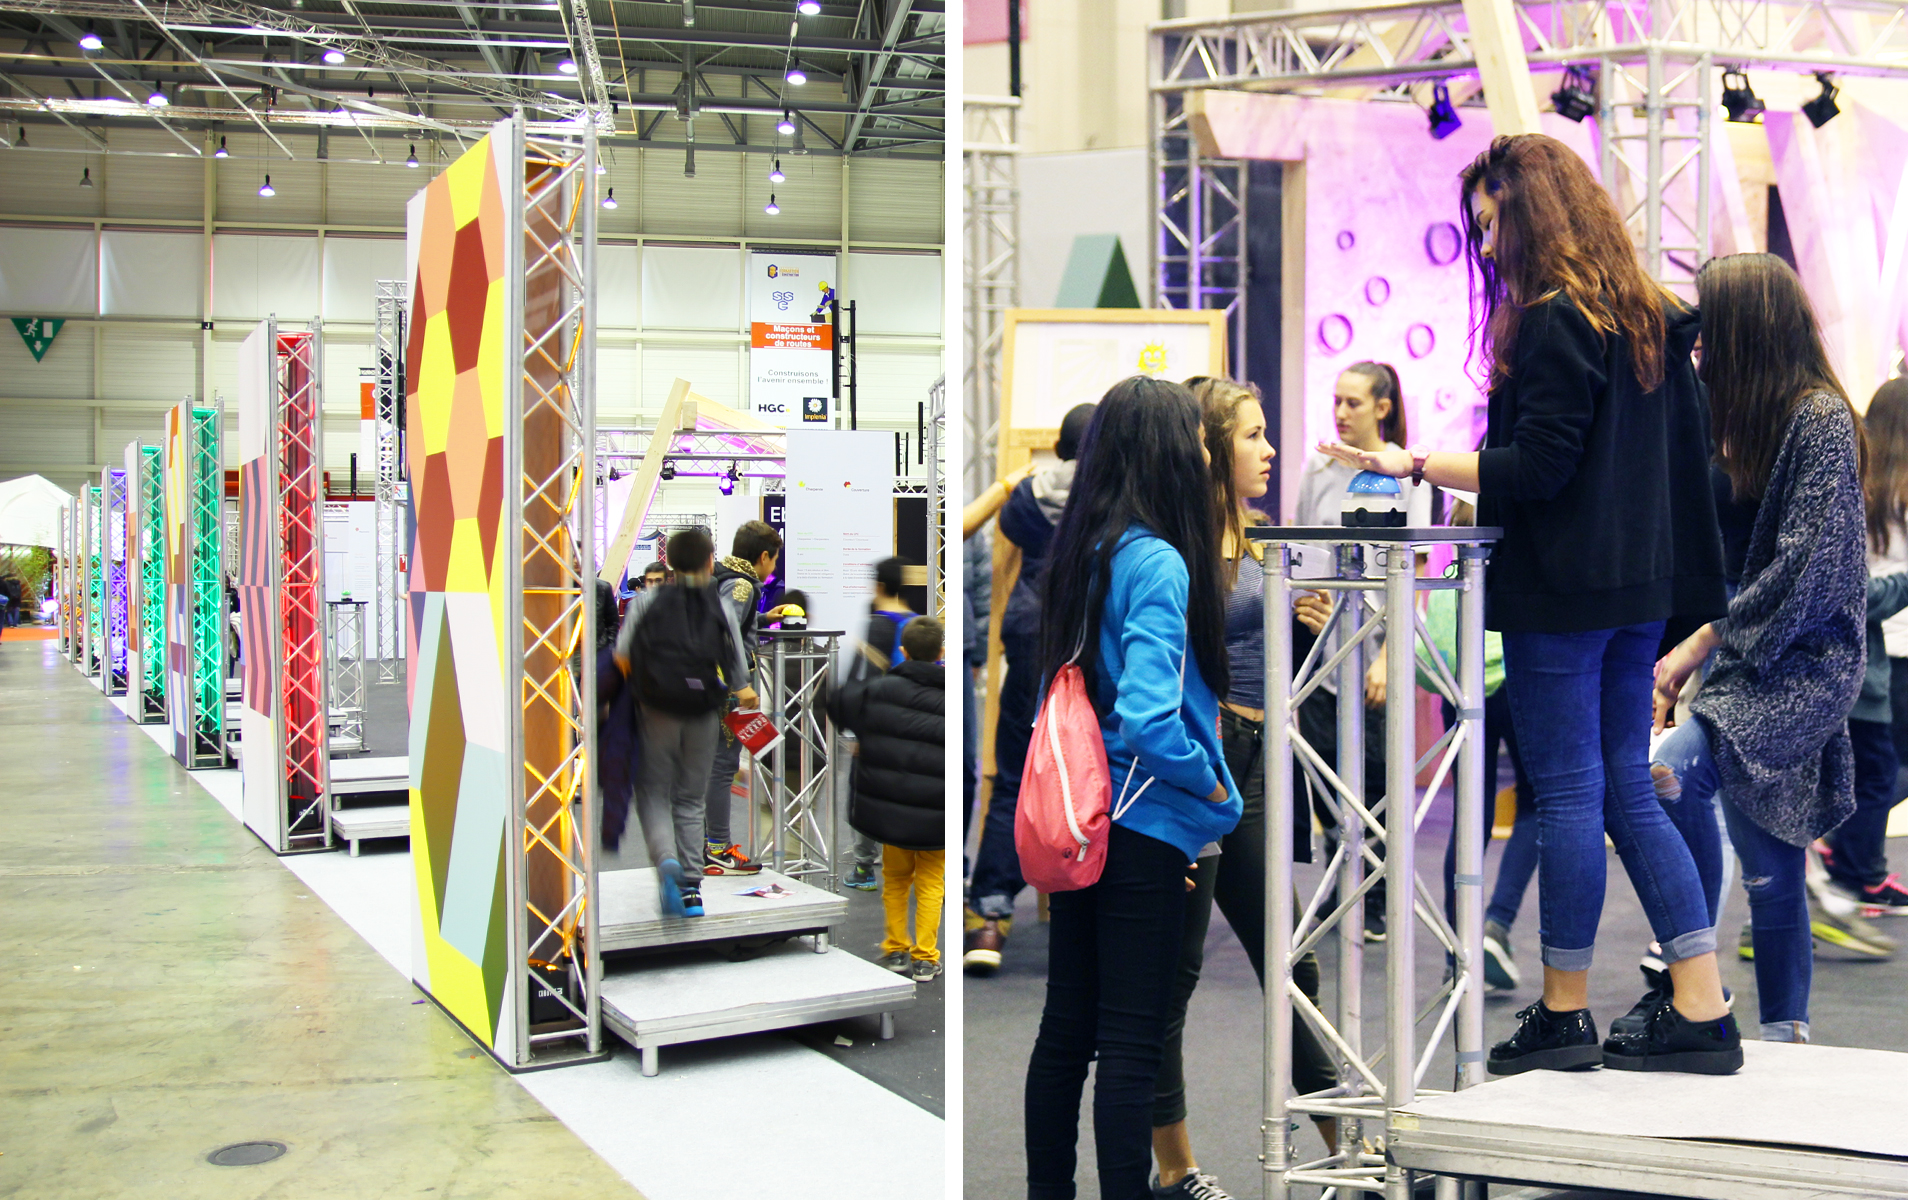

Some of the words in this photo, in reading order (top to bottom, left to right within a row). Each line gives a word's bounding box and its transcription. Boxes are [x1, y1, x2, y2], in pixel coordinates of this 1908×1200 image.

[773, 324, 805, 334] Maçons
[765, 332, 821, 341] constructeurs
[774, 339, 785, 347] de
[786, 340, 812, 348] routes
[768, 369, 819, 378] Construisons
